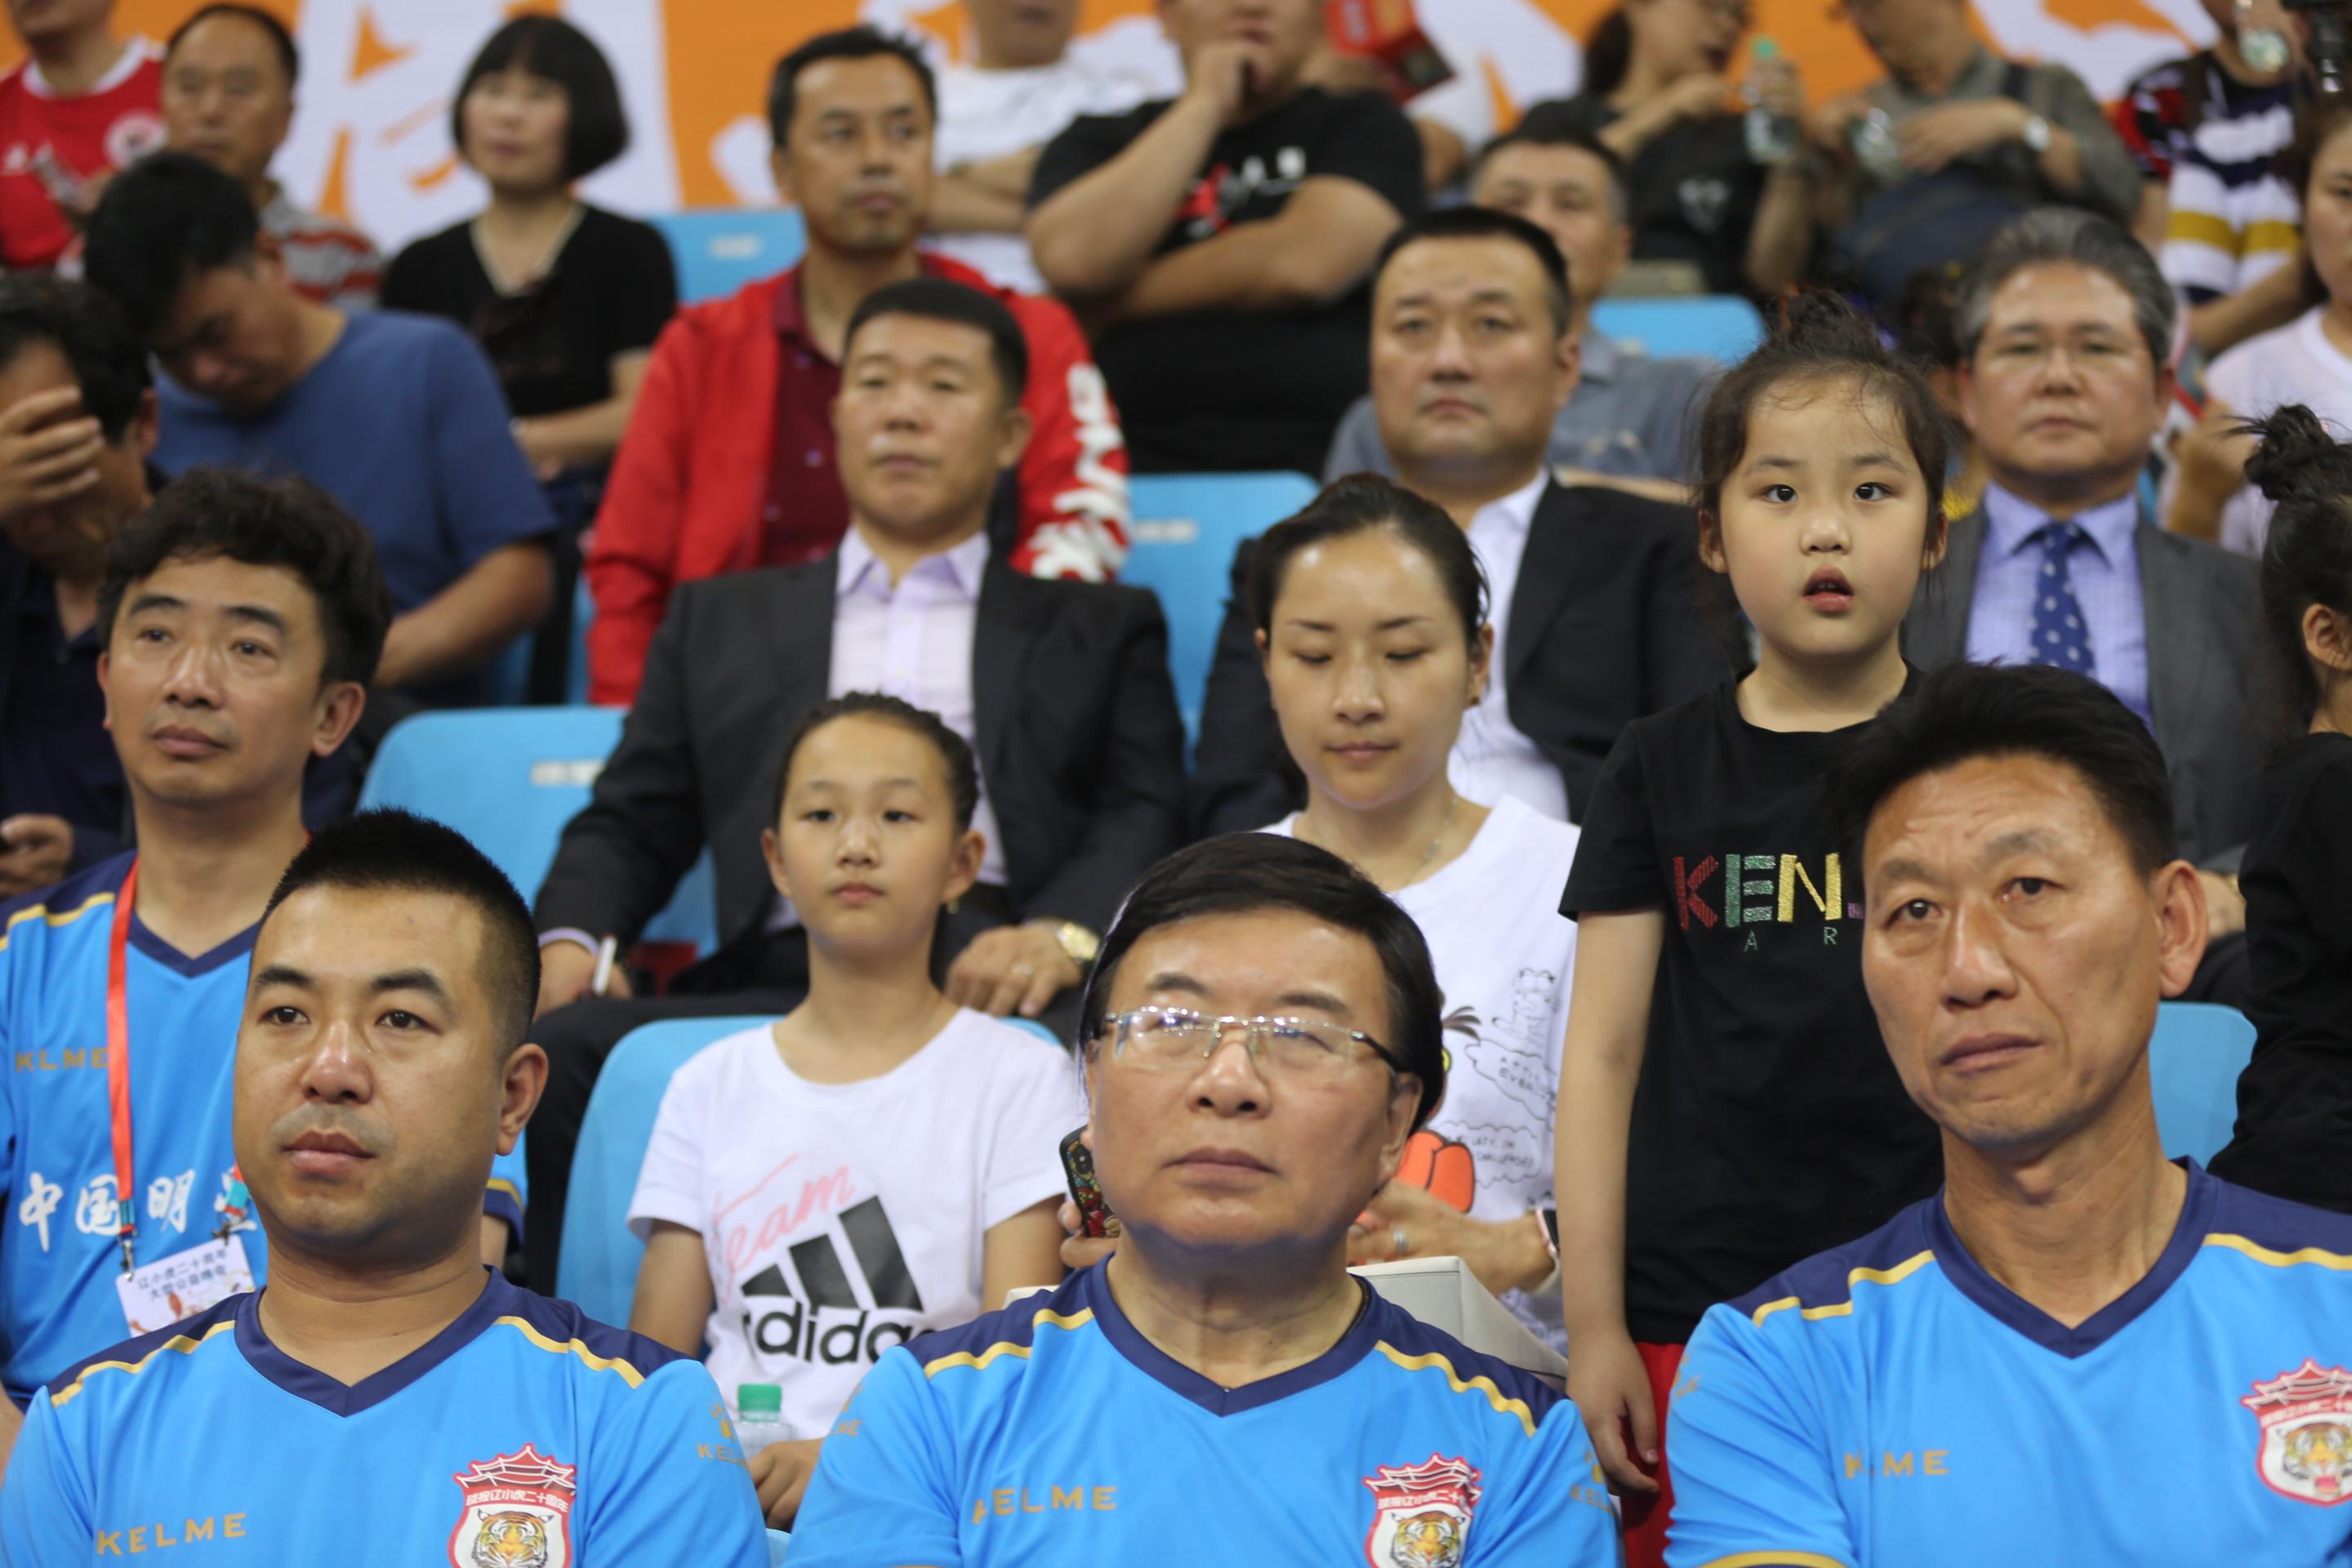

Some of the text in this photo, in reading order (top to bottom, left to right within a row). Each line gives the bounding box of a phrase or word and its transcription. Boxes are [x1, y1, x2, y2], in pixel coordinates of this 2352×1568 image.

[1673, 852, 1864, 929] KEN
[15, 1046, 109, 1072] KLME
[742, 1299, 937, 1365] dida
[1844, 1450, 1949, 1480] KME
[96, 1512, 247, 1556] KELME
